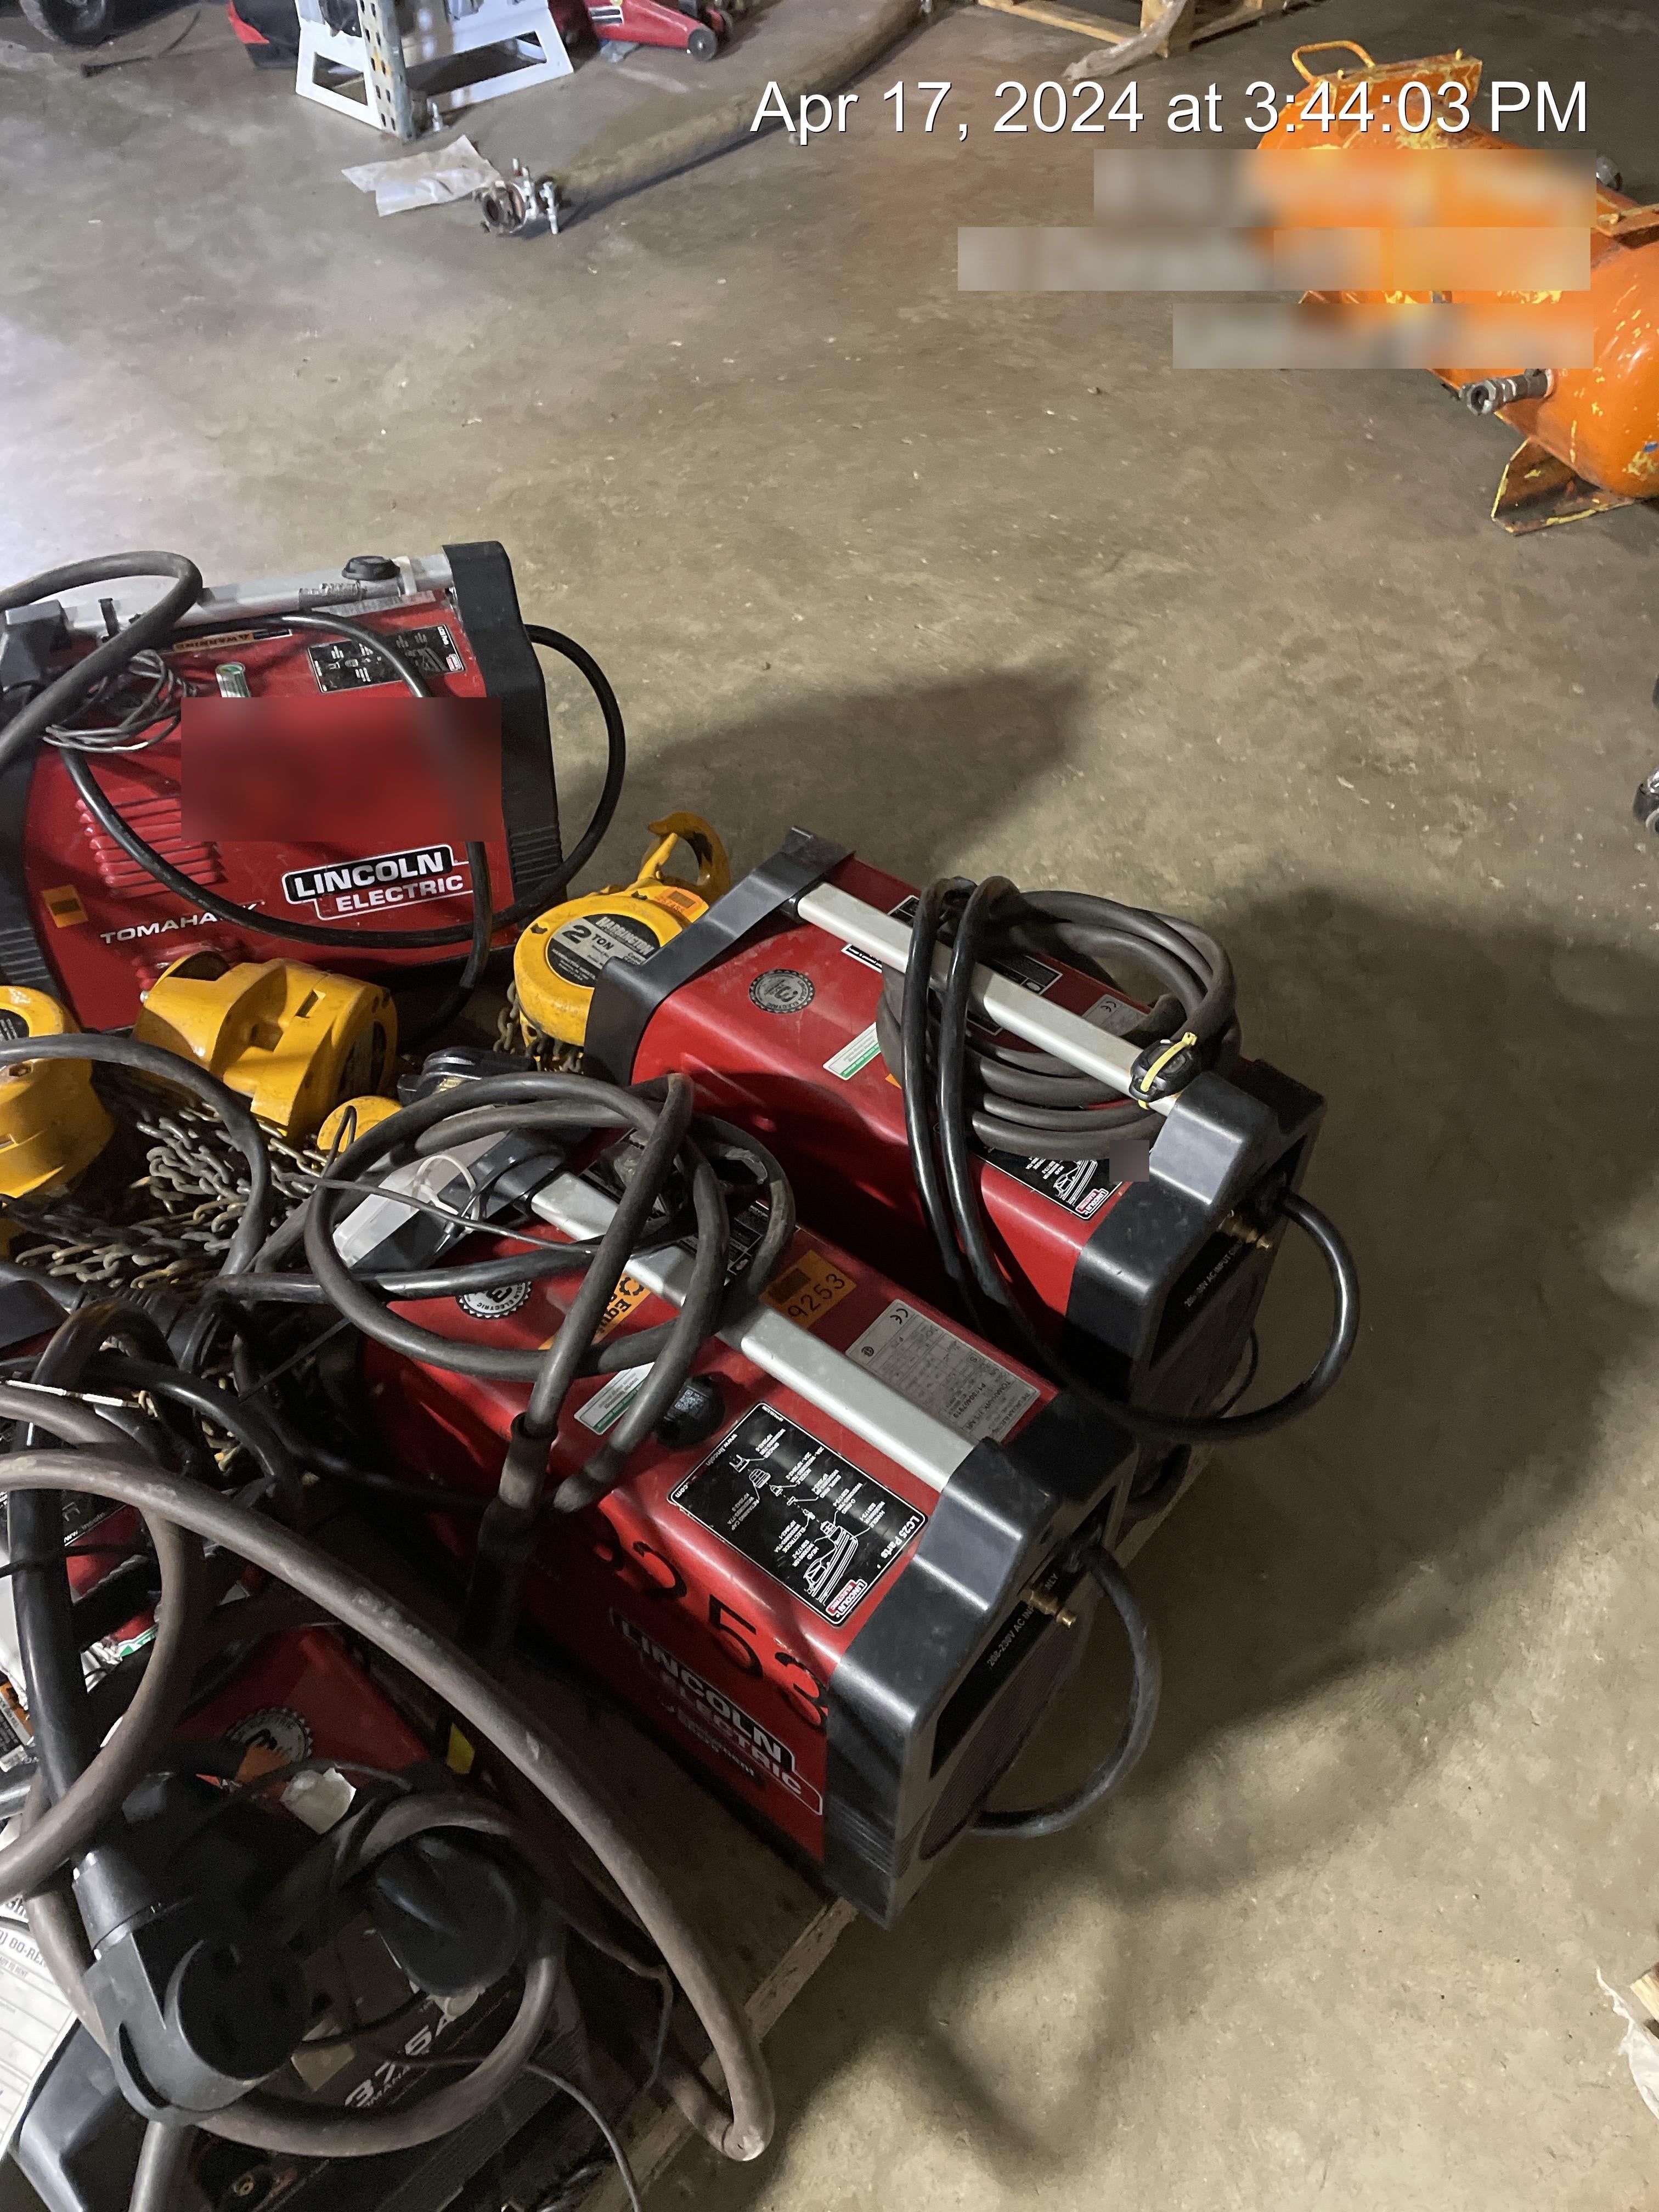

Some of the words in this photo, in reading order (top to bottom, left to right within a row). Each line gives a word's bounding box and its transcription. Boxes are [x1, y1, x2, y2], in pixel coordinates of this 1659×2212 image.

[296, 851, 444, 898] LINCOLN
[336, 874, 464, 912] ELECTRIC
[561, 925, 592, 944] 2
[591, 933, 615, 951] TON
[476, 1300, 514, 1310] ELECTRIC
[788, 1273, 845, 1316] 9253
[729, 1519, 740, 1531] CAP
[898, 1515, 920, 1539] LC25
[782, 1526, 805, 1553] ELECTRODE
[879, 1535, 902, 1560] Parts
[806, 1546, 819, 1560] HEAD
[836, 1582, 864, 1613] LINCOLN
[1012, 1617, 1026, 1632] AC
[622, 1618, 786, 1764] LINCOLN
